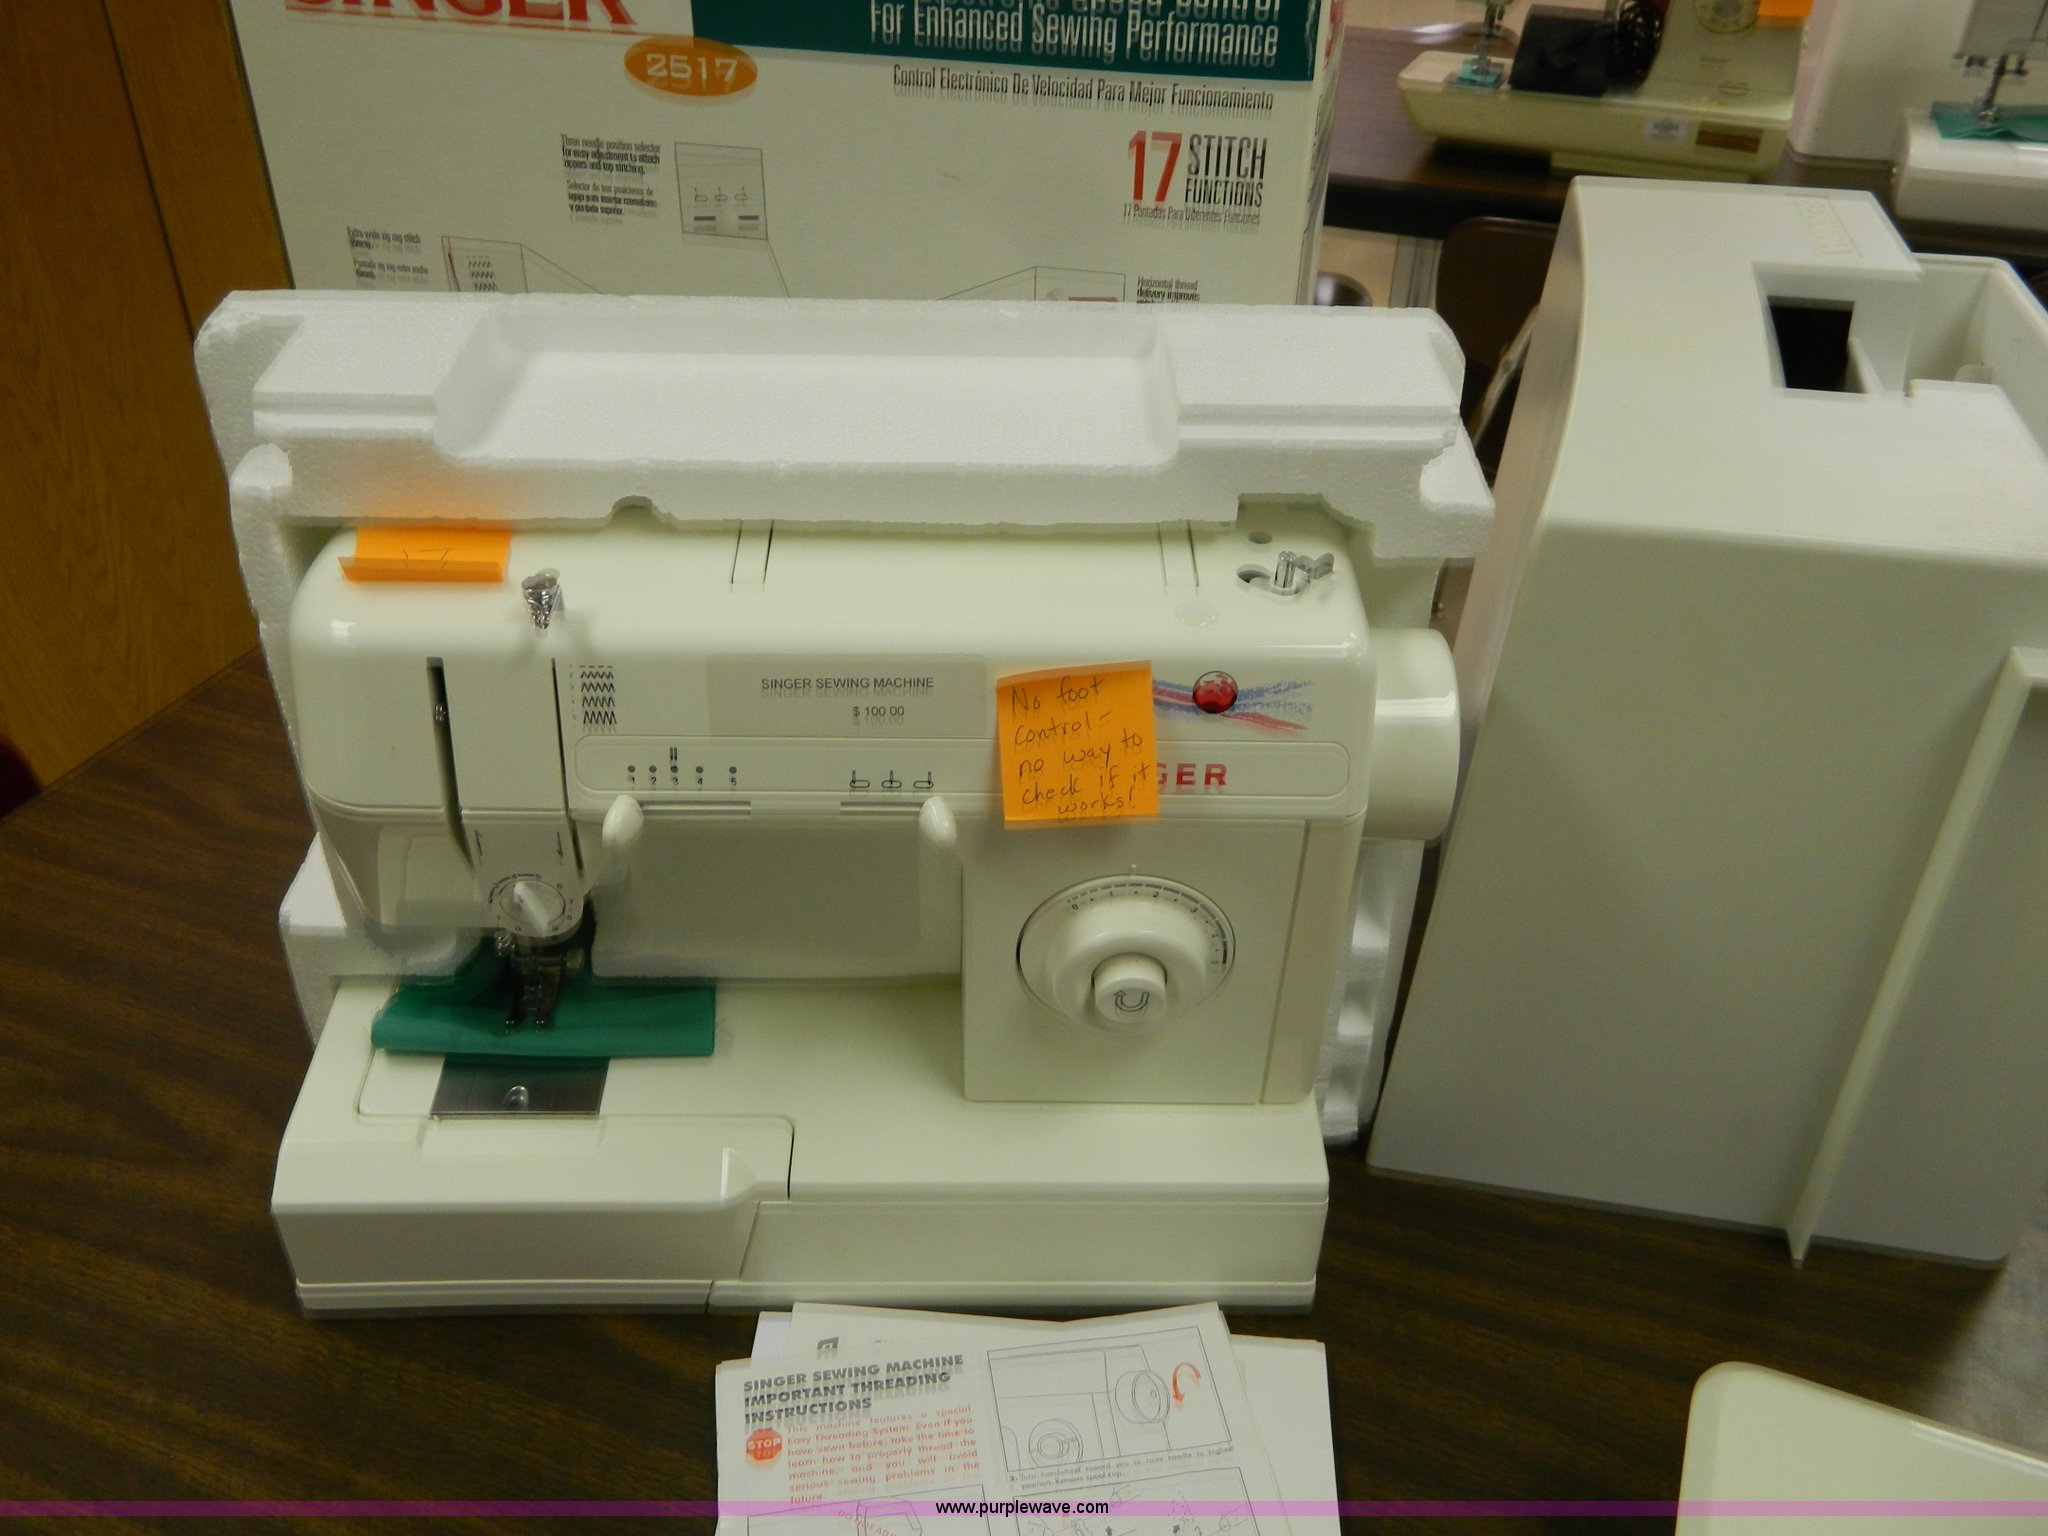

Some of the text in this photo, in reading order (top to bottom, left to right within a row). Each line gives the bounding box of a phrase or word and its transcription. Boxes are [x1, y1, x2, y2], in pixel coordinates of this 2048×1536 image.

[870, 1, 904, 35] For
[914, 1, 1023, 42] Enhanced
[1032, 4, 1117, 52] Sewing
[1127, 10, 1279, 57] Performance
[645, 53, 738, 82] 2517
[894, 64, 1274, 110] Control Electrónico De Velocidad Para Mejor Funcionamiento
[1128, 130, 1182, 201] 17
[1187, 134, 1268, 179] STITCH
[1185, 178, 1264, 207] FUNCTIONS
[761, 677, 934, 689] SINGER SEWING MACHINE
[1012, 675, 1105, 711] No foot
[852, 705, 905, 717] $ 100.00
[1019, 728, 1143, 777] no way to
[1022, 762, 1150, 805] check if it
[1058, 787, 1137, 815] works!
[743, 1354, 964, 1391] SINGER SEWING MACHINE
[744, 1372, 951, 1407] IMPORTANT THREADING
[745, 1397, 872, 1424] INSTRUCTIONS
[816, 1420, 860, 1431] machine
[870, 1414, 912, 1424] features
[935, 1404, 971, 1417] special
[747, 1437, 781, 1450] STOP
[787, 1447, 813, 1456] have
[917, 1432, 935, 1441] the
[937, 1430, 960, 1439] time
[815, 1430, 869, 1441] Threading
[916, 1421, 940, 1430] Even
[953, 1418, 973, 1427] you
[851, 1463, 872, 1473] and
[885, 1460, 905, 1470] you
[918, 1454, 937, 1464] will
[949, 1449, 978, 1460] avoid
[867, 1446, 912, 1460] properly
[918, 1441, 953, 1453] thread
[960, 1438, 976, 1447] the
[789, 1481, 828, 1492] serious
[838, 1475, 876, 1486] sewing
[885, 1468, 936, 1482] problems
[962, 1461, 980, 1471] the
